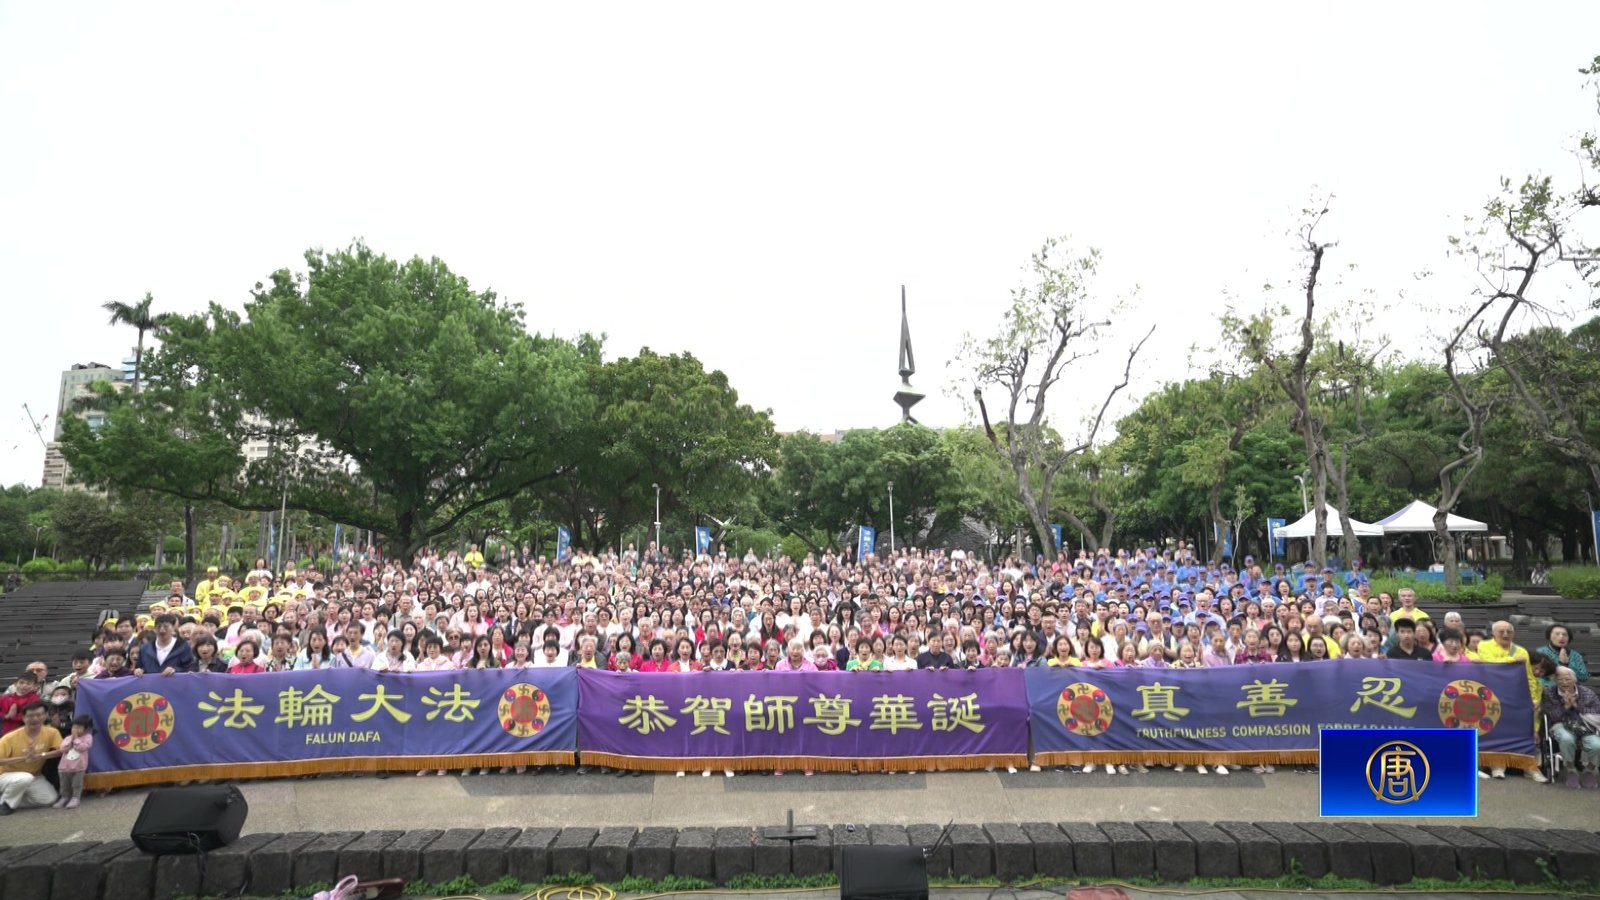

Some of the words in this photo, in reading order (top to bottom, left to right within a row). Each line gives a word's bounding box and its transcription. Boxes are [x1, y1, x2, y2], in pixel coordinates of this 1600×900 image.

[198, 683, 481, 729] 法輪大法
[619, 693, 986, 735] 恭賀師尊華誕
[1132, 676, 1417, 720] 真善忍
[305, 733, 345, 744] FALUN
[349, 731, 381, 743] DAFA
[1136, 727, 1227, 739] TRUTHFULNESS
[1232, 724, 1311, 737] COMPASSION
